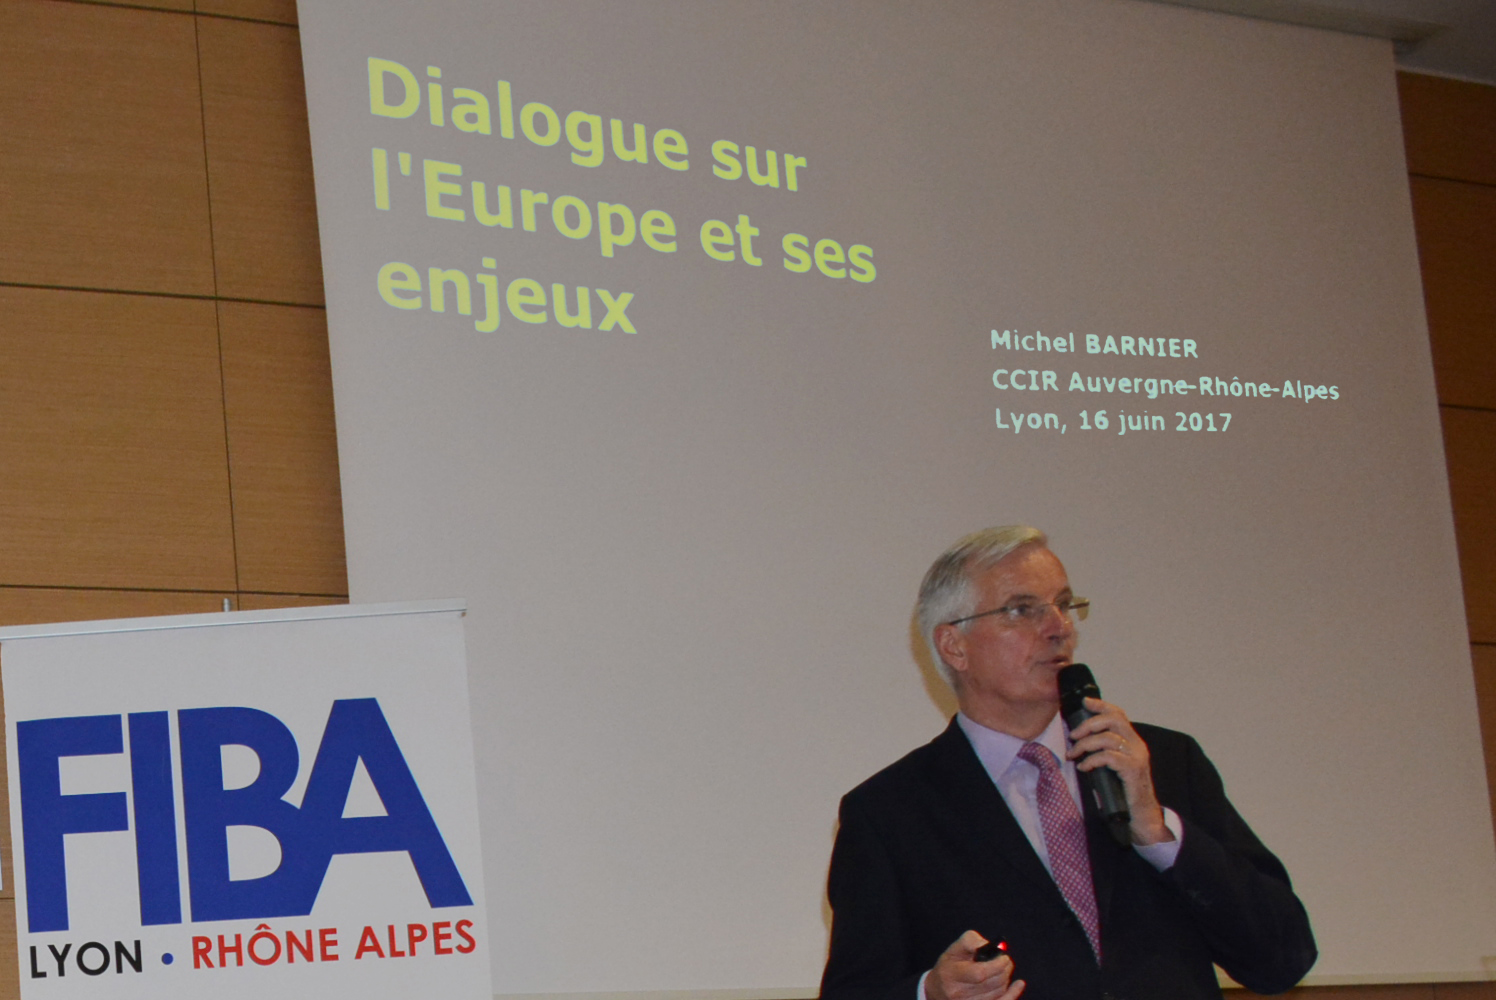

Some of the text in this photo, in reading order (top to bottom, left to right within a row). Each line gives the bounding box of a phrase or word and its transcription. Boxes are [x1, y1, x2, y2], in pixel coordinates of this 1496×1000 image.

[367, 56, 807, 192] Dialogue sur
[371, 146, 877, 283] l'Europe et ses
[377, 256, 638, 335] enjeux
[990, 329, 1199, 358] Michel BARNIER
[992, 368, 1341, 403] CCIR Auvergne-Rhône-Alpes
[995, 408, 1233, 436] Lyon, 16 juin 2017
[16, 696, 475, 934] FIBA
[29, 919, 477, 979] LYON RHÔNE ALPES
